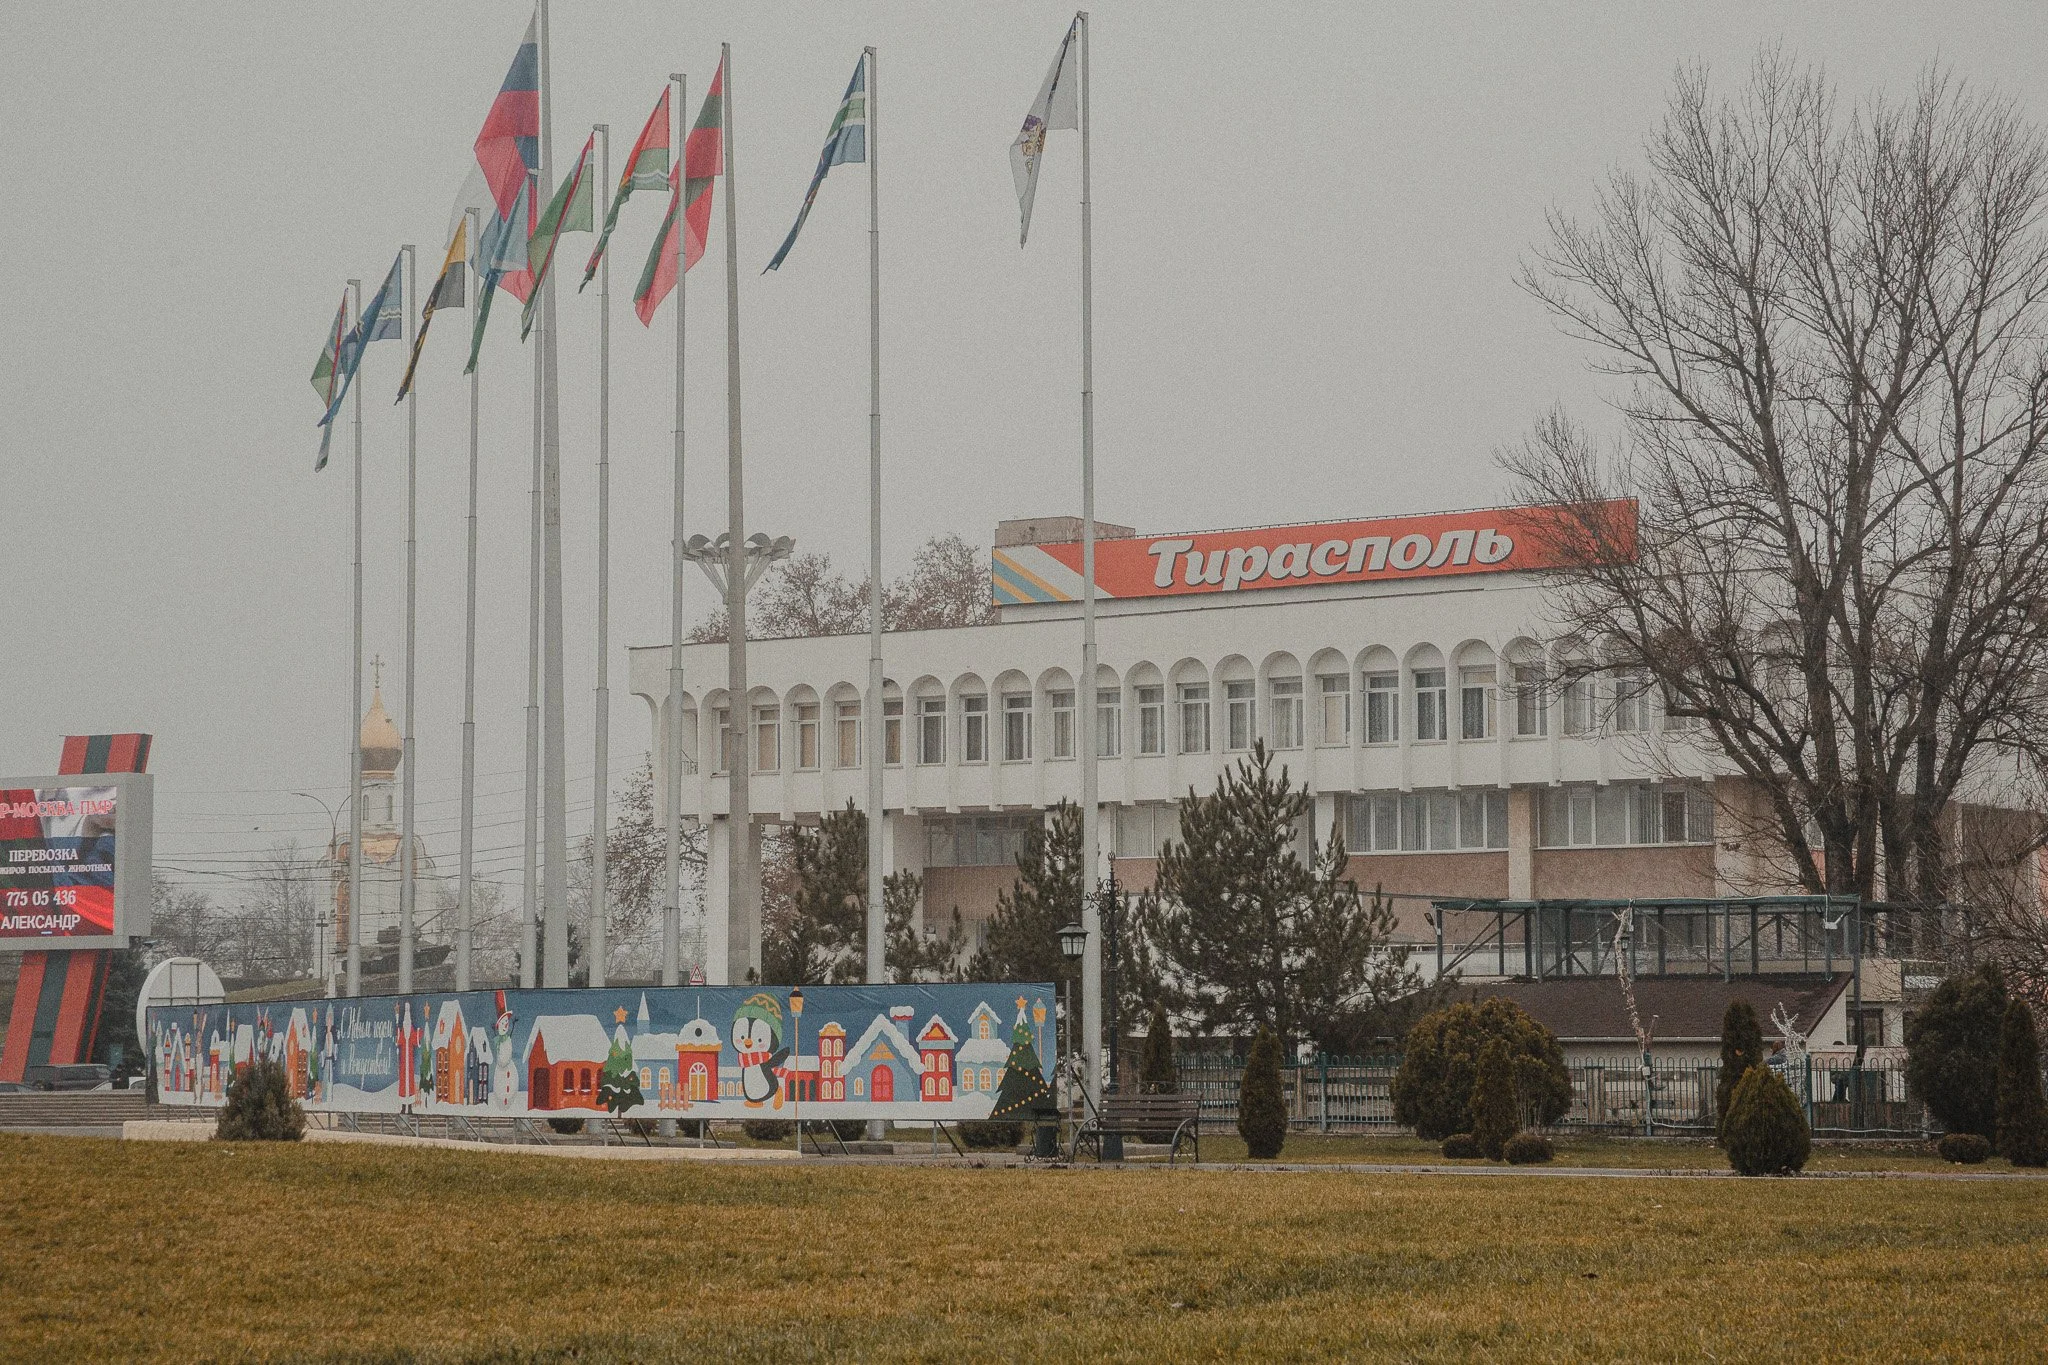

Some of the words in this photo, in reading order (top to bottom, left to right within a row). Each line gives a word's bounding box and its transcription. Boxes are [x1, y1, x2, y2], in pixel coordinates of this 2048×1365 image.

[1148, 529, 1514, 591] Тирасполь
[9, 848, 79, 862] ПЕРЕВОЗКА
[28, 865, 65, 874] ПОСЫЛОК
[68, 864, 112, 873] ЖИВОТНЫХ
[6, 891, 28, 906] 775
[32, 891, 49, 906] 05
[53, 890, 76, 905] 436
[1, 915, 81, 930] АЛЕКСАНДР
